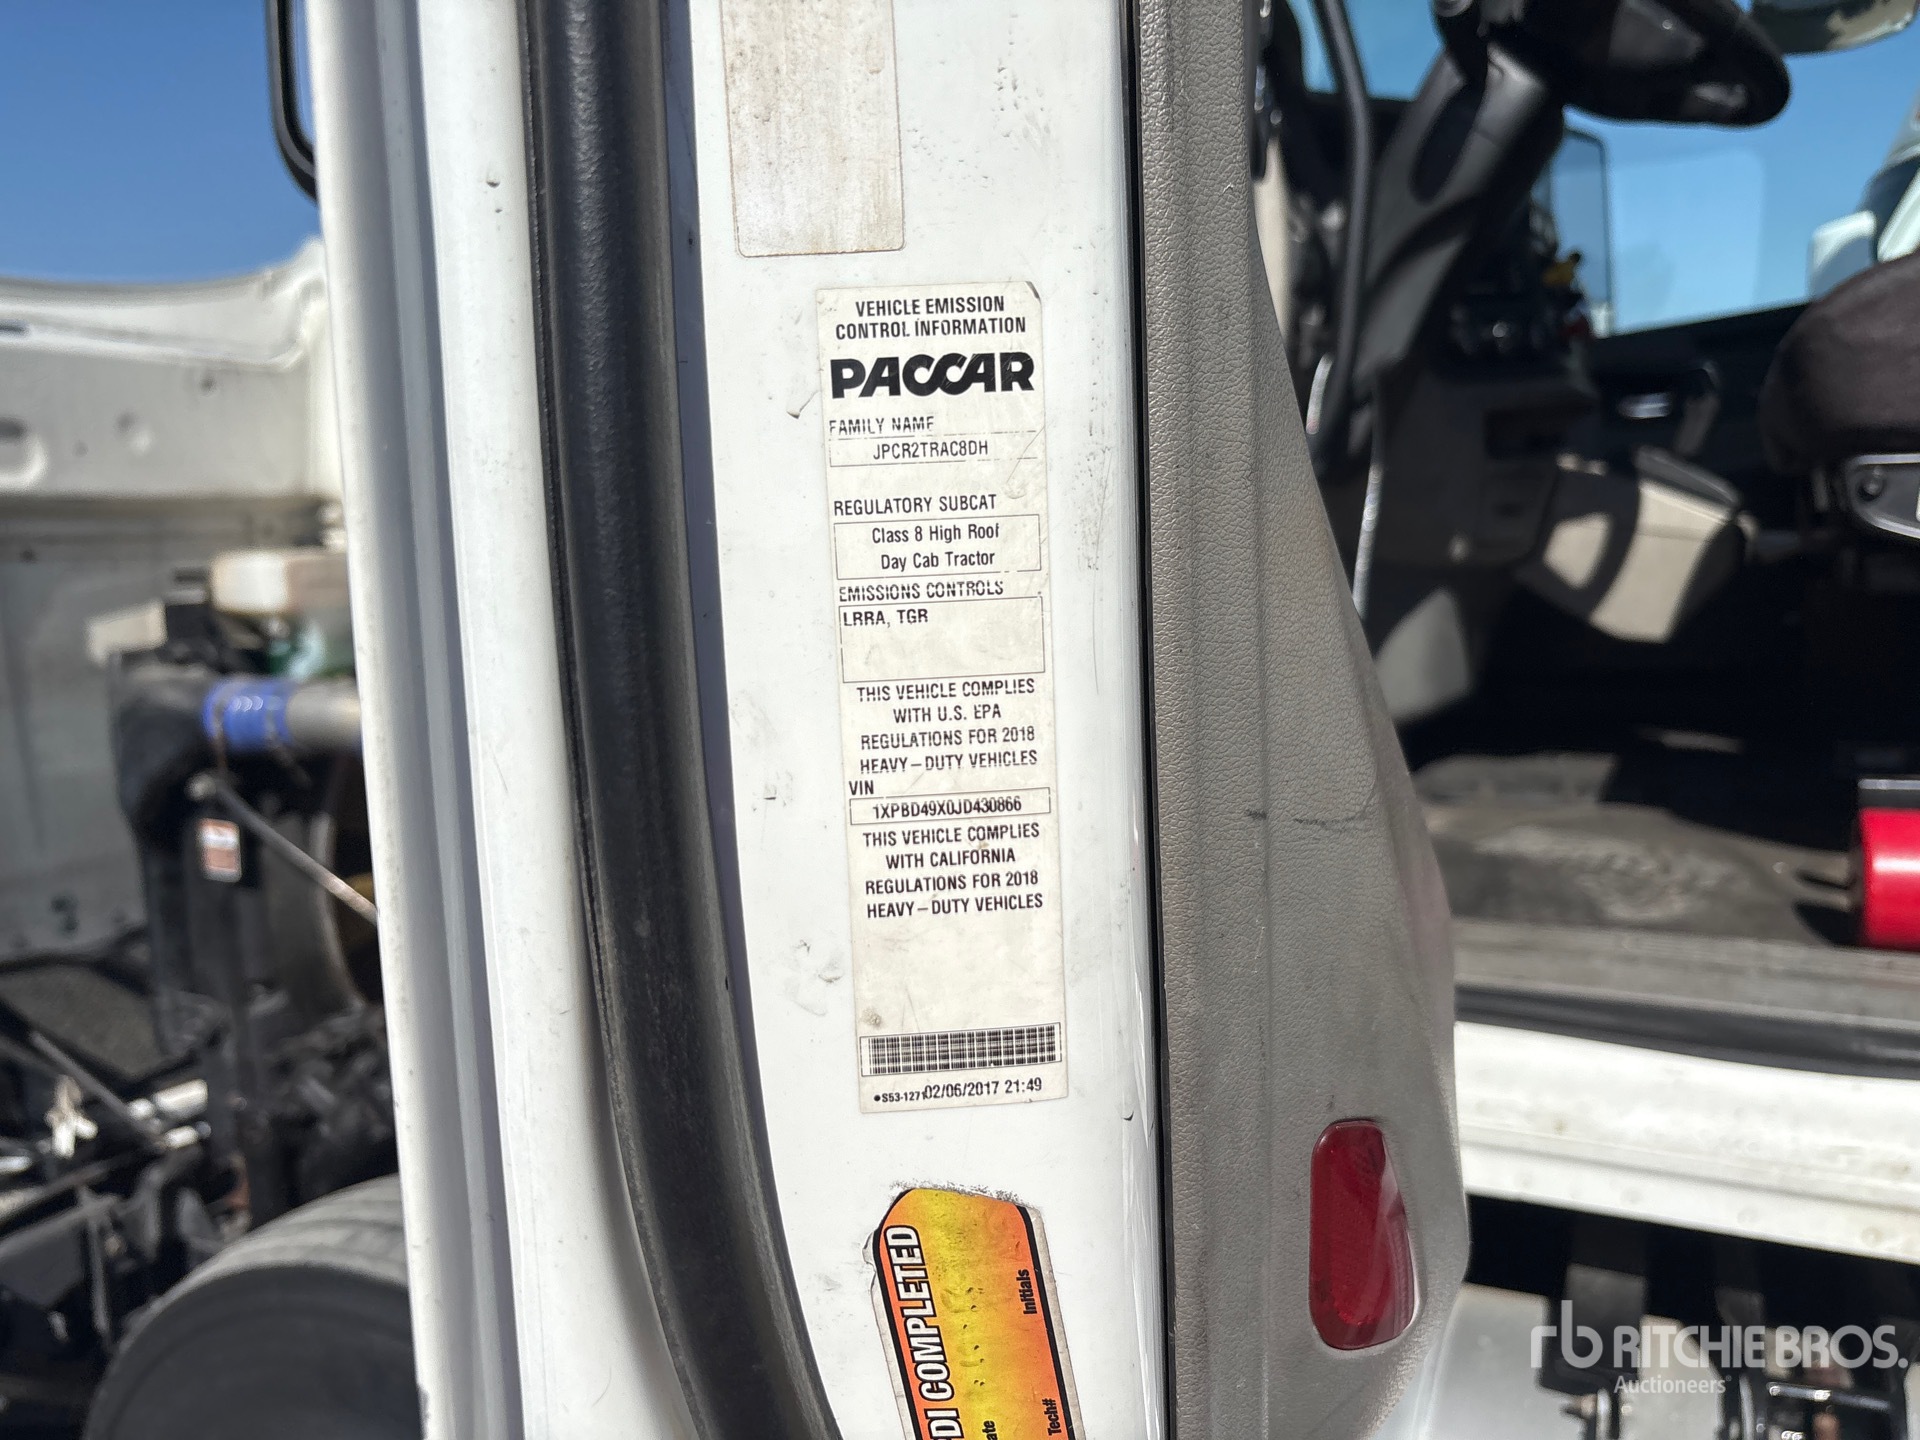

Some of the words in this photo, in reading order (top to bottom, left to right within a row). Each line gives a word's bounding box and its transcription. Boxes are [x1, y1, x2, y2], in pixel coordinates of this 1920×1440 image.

[856, 299, 920, 317] VEHICLE
[926, 296, 1004, 314] EMISSION
[836, 322, 910, 340] CONTROL
[914, 317, 1026, 336] INFORMATION
[830, 352, 1034, 399] PACCAR
[829, 418, 884, 436] FAMILY
[873, 440, 988, 460] JPCR2TRAC8DH
[834, 497, 932, 516] REGULATORY
[939, 494, 997, 512] SUBCAT
[872, 527, 909, 544] Class
[914, 526, 923, 542] 8
[929, 524, 962, 544] High
[881, 555, 907, 572] Day
[913, 552, 939, 569] Cab
[946, 551, 995, 567] Tractor
[839, 583, 920, 602] EMISSIONS
[926, 580, 1004, 598] CONTROLS
[843, 611, 891, 628] LRRA,
[896, 608, 928, 624] TGR
[856, 686, 891, 702] THIS
[896, 682, 956, 700] VEHICLE
[962, 678, 1035, 697] COMPLIES
[893, 706, 931, 723] WITH
[938, 705, 967, 722] U.S.
[974, 703, 1001, 720] EPA
[861, 730, 962, 750] REGULATIONS
[968, 728, 997, 744] FOR
[1002, 726, 1035, 743] 2018
[968, 750, 1038, 768] VEHICLES
[848, 780, 874, 796] VIN
[863, 831, 897, 847] THIS
[902, 828, 962, 845] VEHICLE
[968, 822, 1040, 841] COMPLIES
[886, 853, 924, 870] WITH
[930, 848, 1016, 867] CALIFORNIA
[865, 875, 966, 895] REGULATIONS
[972, 872, 1001, 889] FOR
[1006, 870, 1038, 887] 2018
[974, 893, 1043, 912] VEHICLES
[924, 1080, 1000, 1100] 02/06/2017
[1004, 1077, 1042, 1094] 21:49
[1016, 1268, 1038, 1315] Initials
[884, 1225, 954, 1401] COMPLETED
[924, 1408, 965, 1440] DI
[1041, 1398, 1062, 1436] Tech#
[982, 1420, 998, 1440] ate
